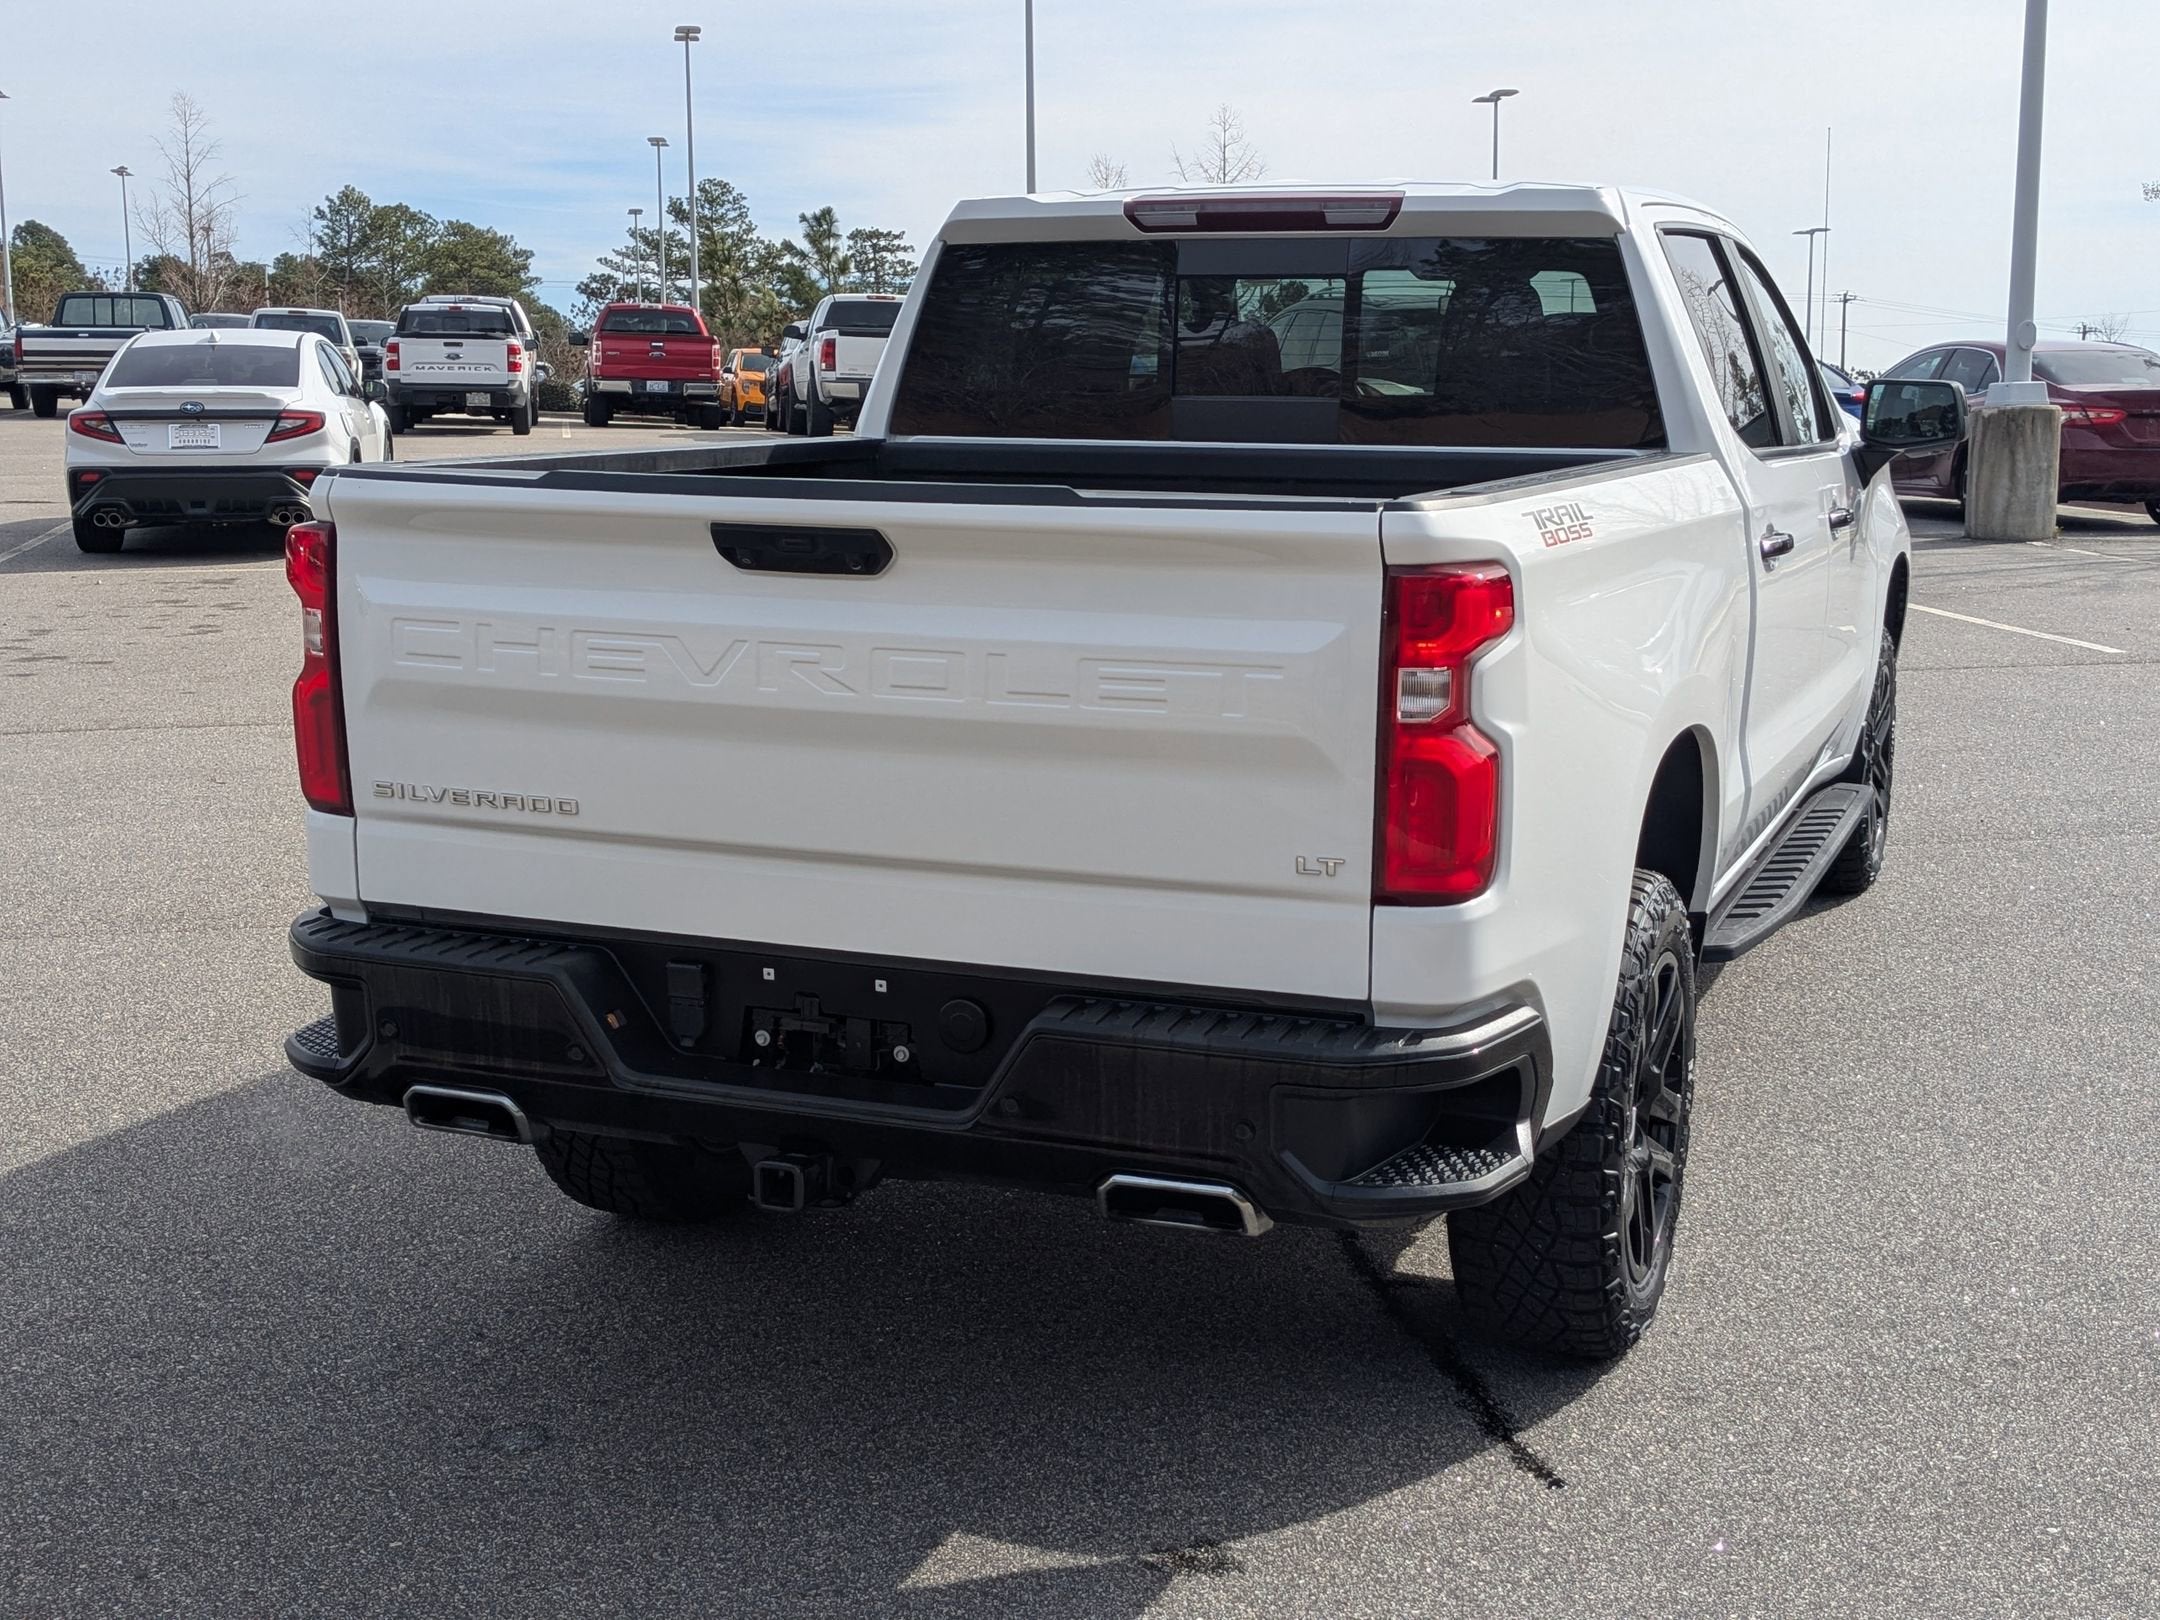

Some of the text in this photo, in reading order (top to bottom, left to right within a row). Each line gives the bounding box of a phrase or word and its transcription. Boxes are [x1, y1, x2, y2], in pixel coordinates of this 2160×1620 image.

[1521, 503, 1594, 530] TRAIL
[1540, 522, 1593, 547] BOSS
[391, 617, 1285, 718] CHEVROLET
[373, 780, 580, 816] SILVERADO
[1296, 855, 1346, 877] LT
